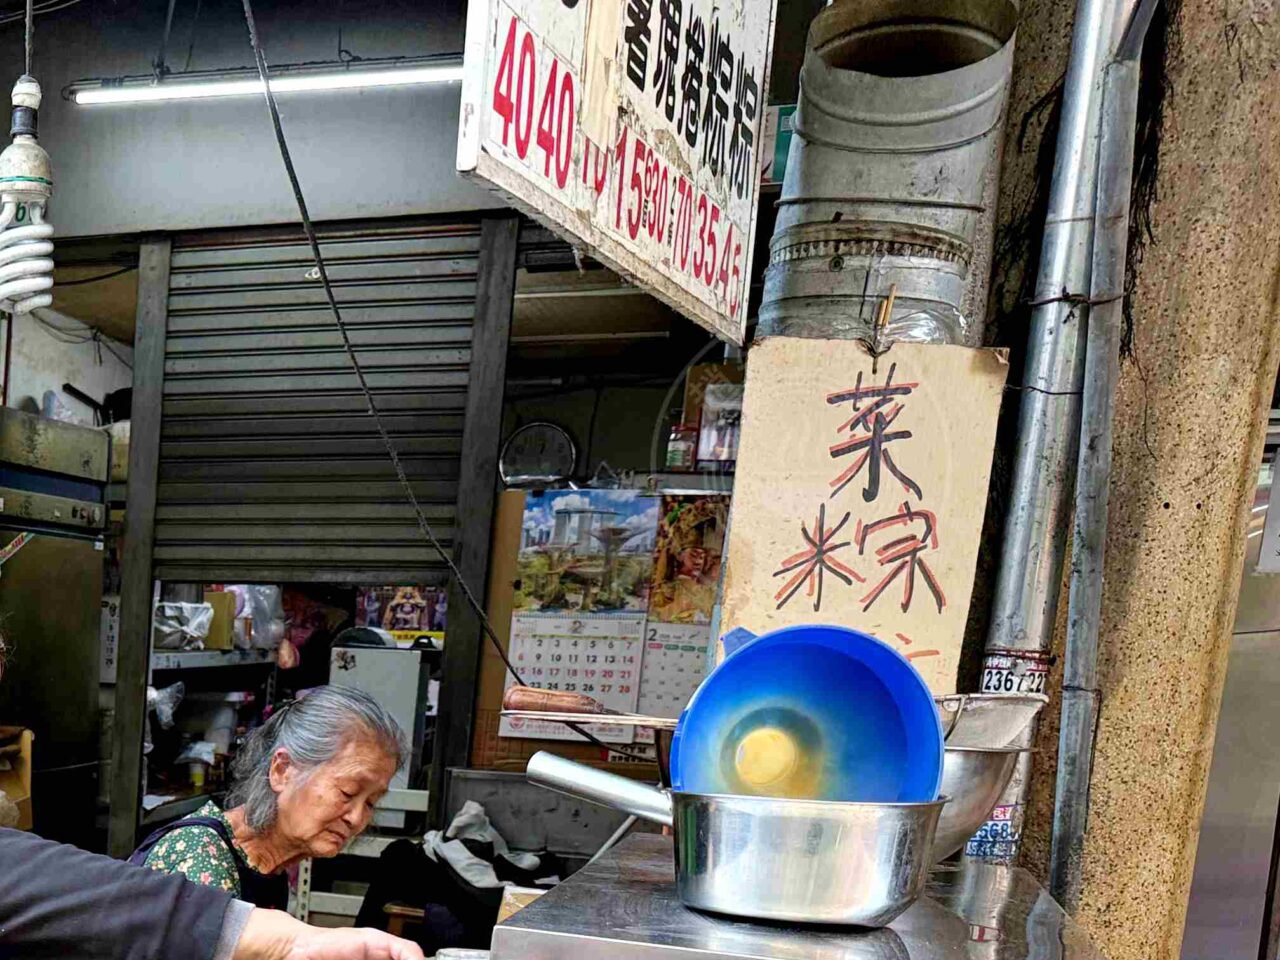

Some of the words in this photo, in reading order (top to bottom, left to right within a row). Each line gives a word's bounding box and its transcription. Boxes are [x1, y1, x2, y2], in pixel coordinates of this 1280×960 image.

[493, 16, 535, 160] 40
[537, 58, 574, 189] 40
[693, 193, 720, 287] 35
[648, 628, 657, 641] 2
[537, 639, 543, 647] 2
[554, 639, 561, 648] 3
[572, 640, 578, 648] 4
[590, 640, 596, 649] 5
[535, 654, 542, 662] 9
[551, 654, 562, 662] 10
[569, 655, 578, 663] 11
[586, 655, 597, 663] 12
[622, 656, 634, 664] 14
[532, 667, 542, 676] 16
[549, 668, 559, 676] 17
[547, 682, 558, 690] 24
[565, 682, 576, 691] 25
[583, 683, 594, 692] 26
[600, 684, 612, 693] 27
